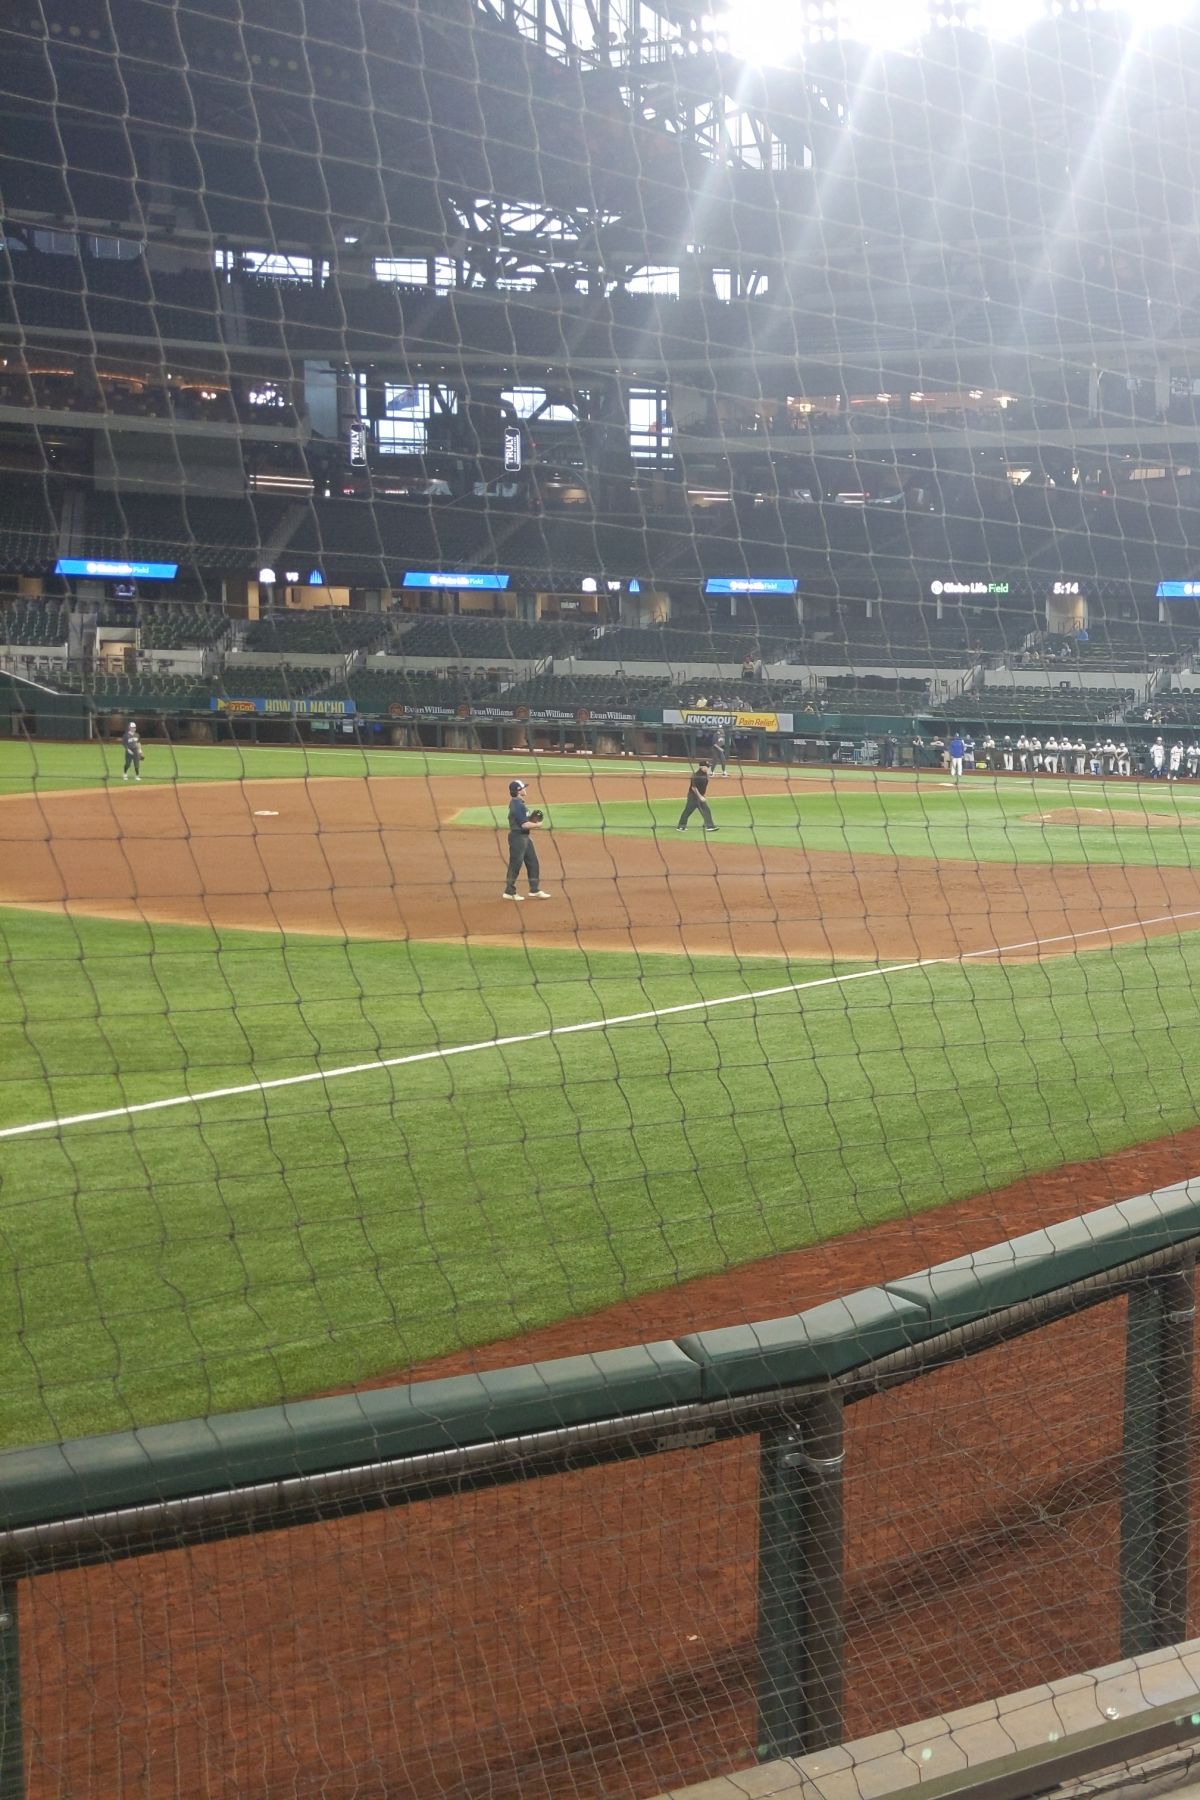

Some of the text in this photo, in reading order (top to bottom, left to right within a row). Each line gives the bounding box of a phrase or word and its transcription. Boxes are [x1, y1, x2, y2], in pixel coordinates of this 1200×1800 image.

[351, 430, 360, 460] TRULY
[505, 434, 514, 464] TRULY
[943, 582, 1009, 594] Globe Life Field
[1053, 582, 1080, 595] 5:14
[265, 699, 290, 712] HOW
[310, 701, 345, 713] NACHO
[687, 714, 737, 725] KNOCKOUT
[739, 718, 754, 726] Pain
